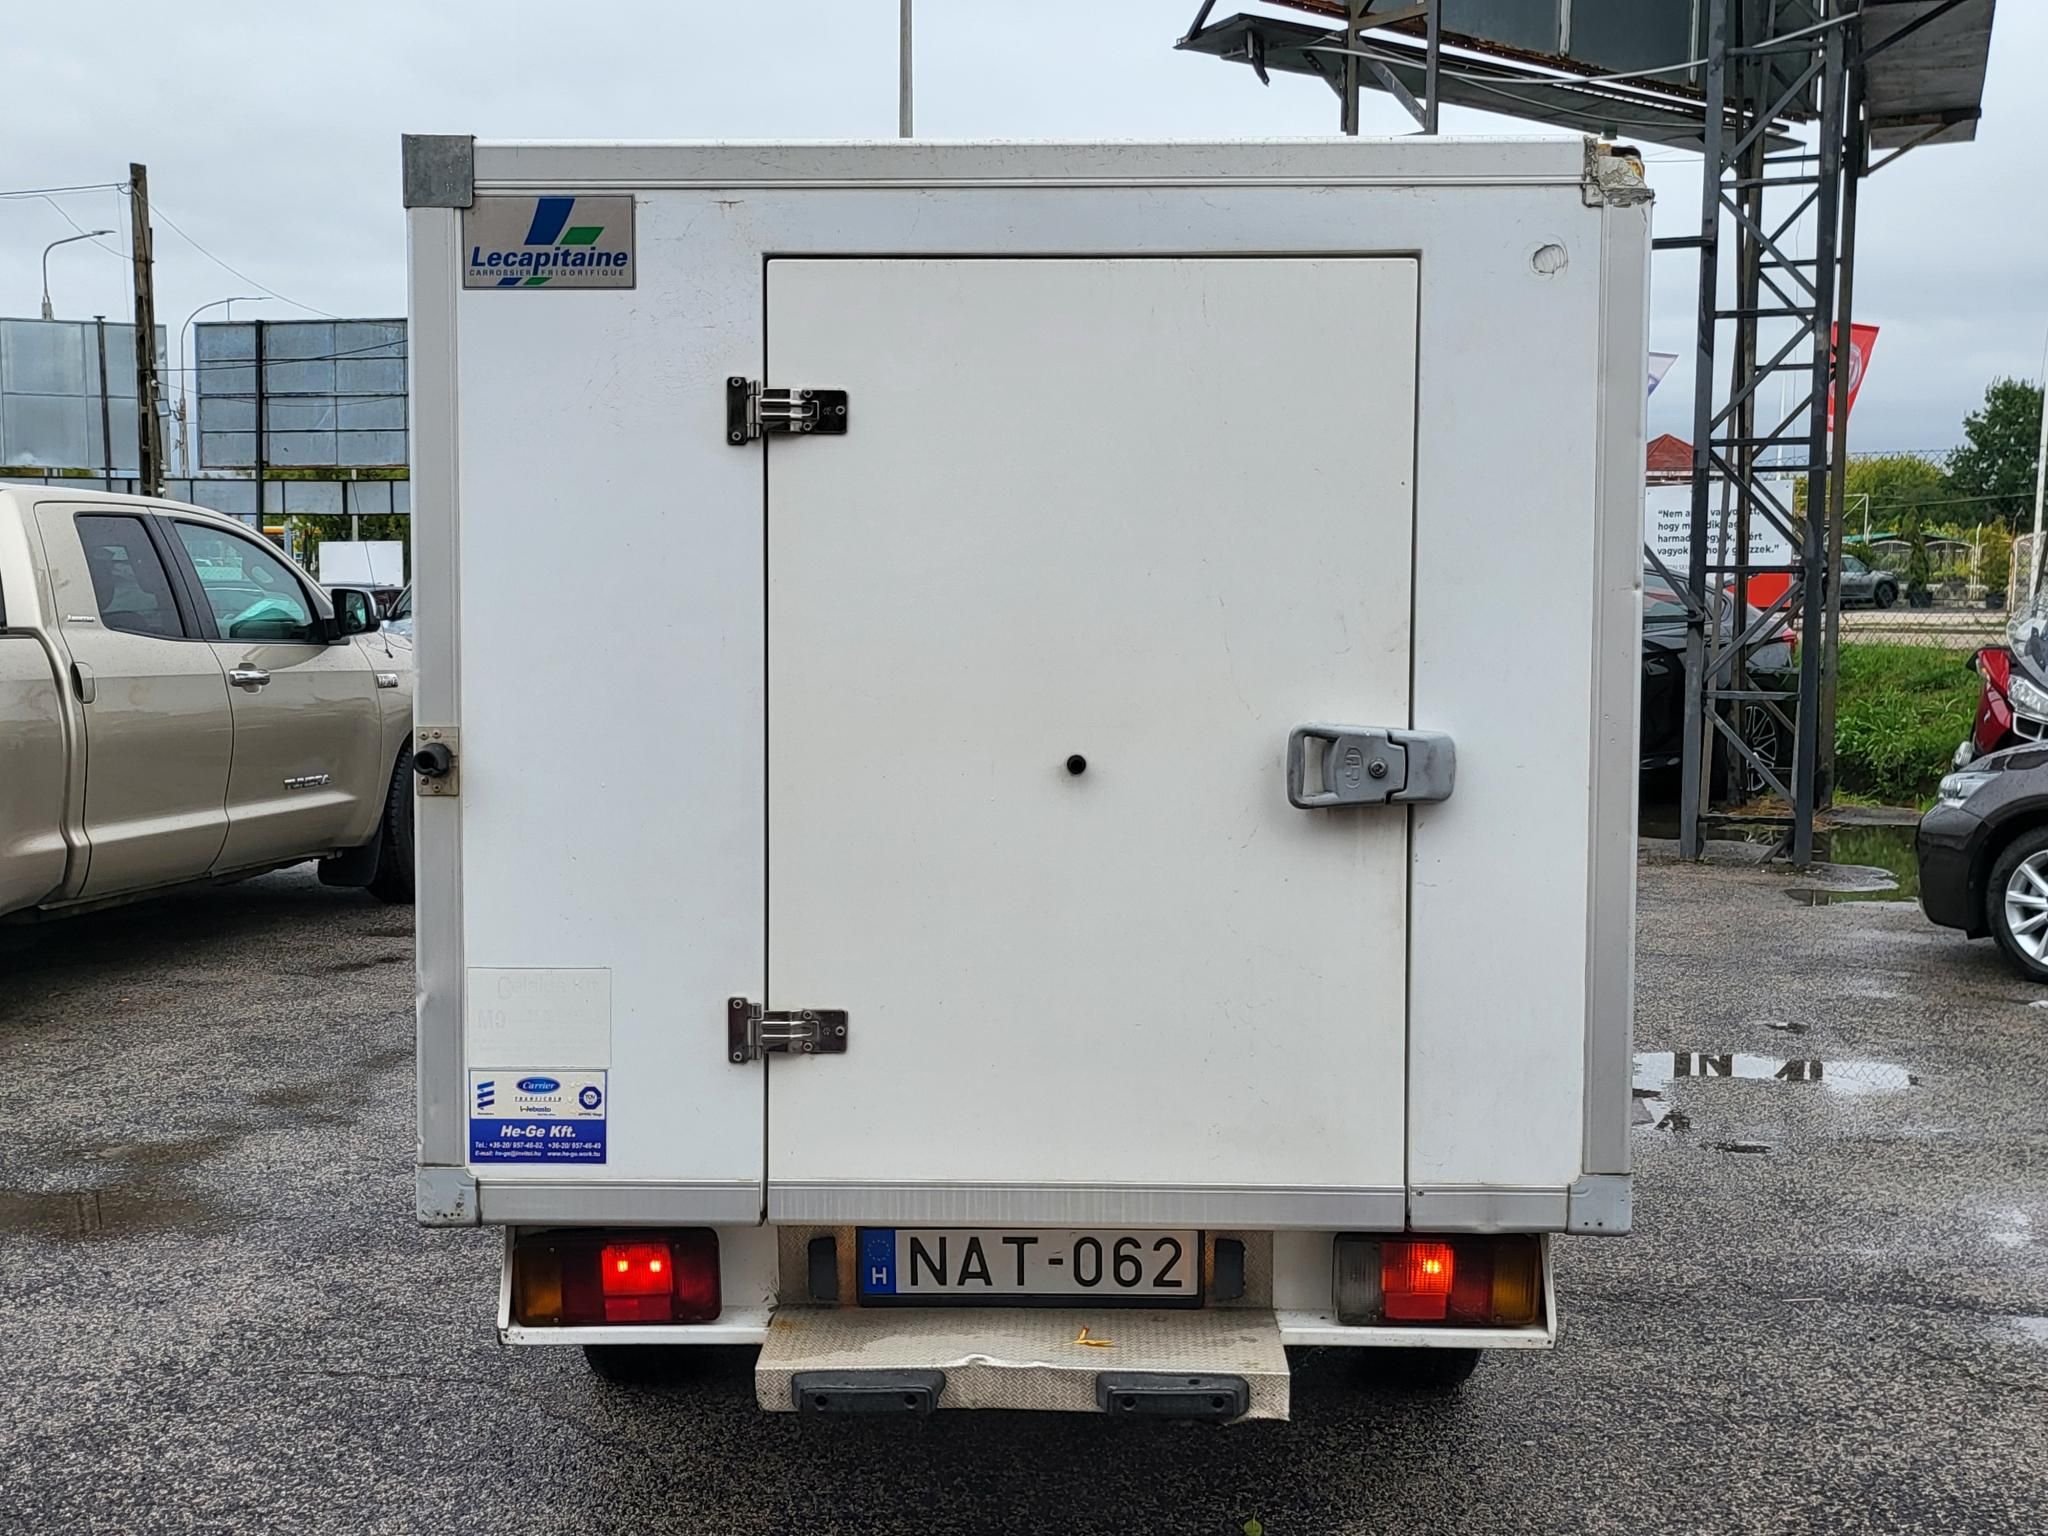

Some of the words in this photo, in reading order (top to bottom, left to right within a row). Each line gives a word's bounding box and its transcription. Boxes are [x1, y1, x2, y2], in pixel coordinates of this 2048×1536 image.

[471, 246, 628, 276] Lecapitaine
[469, 269, 531, 277] CARROSSIER
[541, 269, 625, 277] FRIGORIFIQUE
[1658, 522, 1680, 532] hogy
[1657, 547, 1689, 557] vagyok
[522, 1081, 556, 1091] Carrier
[520, 1105, 551, 1113] Webasto
[500, 1125, 545, 1137] He-Ge
[549, 1125, 576, 1138] Kft.
[871, 1267, 887, 1285] H
[909, 1236, 1183, 1288] NAT-062
